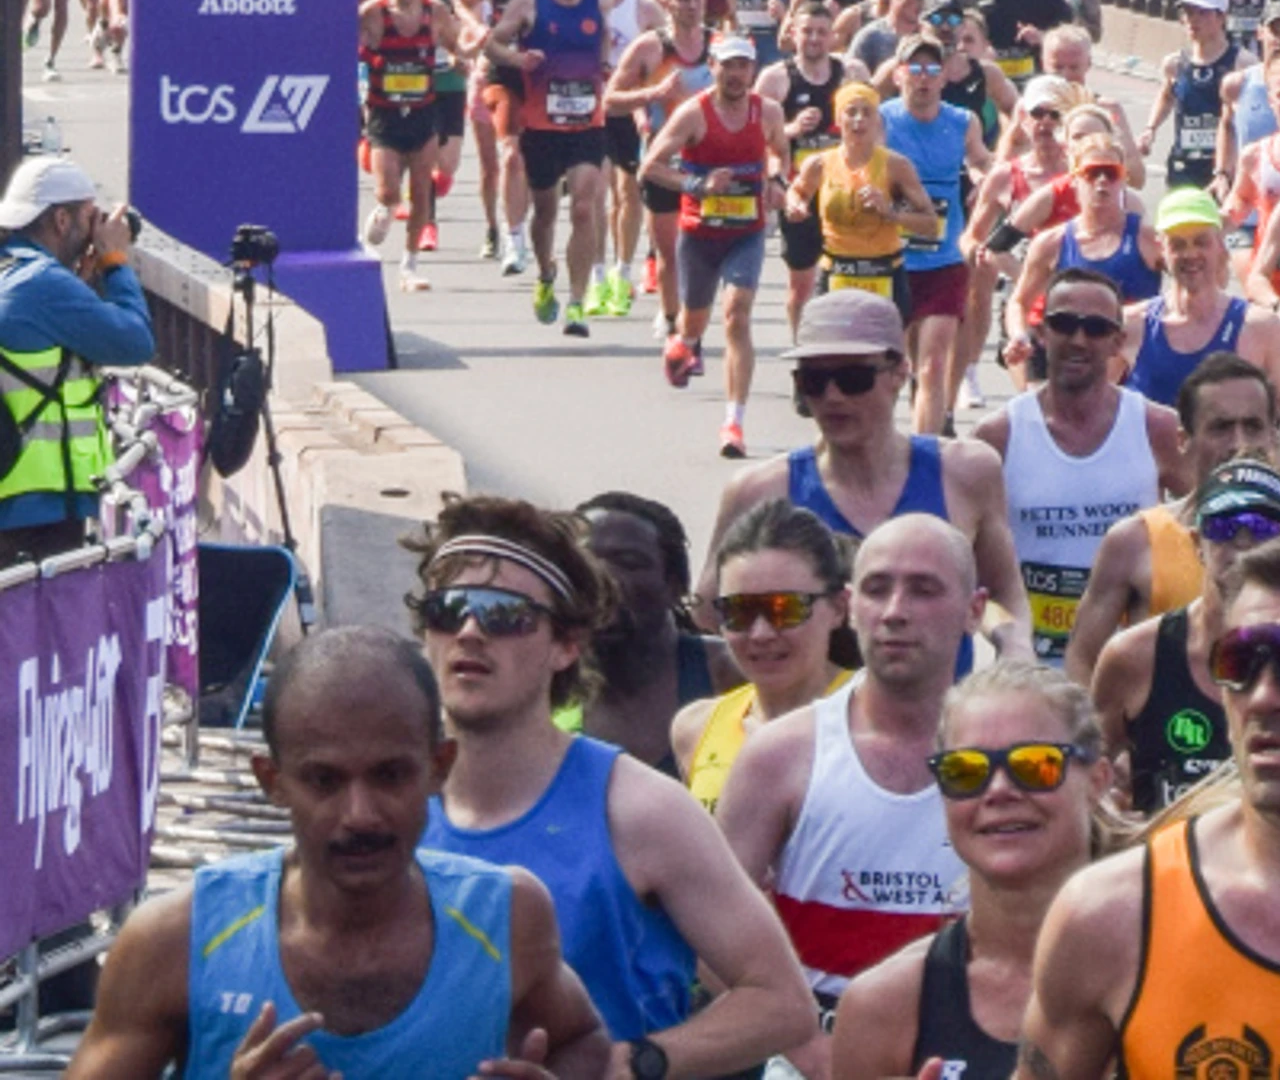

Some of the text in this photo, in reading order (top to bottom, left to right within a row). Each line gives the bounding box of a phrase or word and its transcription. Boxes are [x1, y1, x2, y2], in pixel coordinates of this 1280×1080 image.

[160, 74, 236, 125] tcs
[861, 871, 942, 889] BRISTOL
[873, 888, 928, 905] WEST
